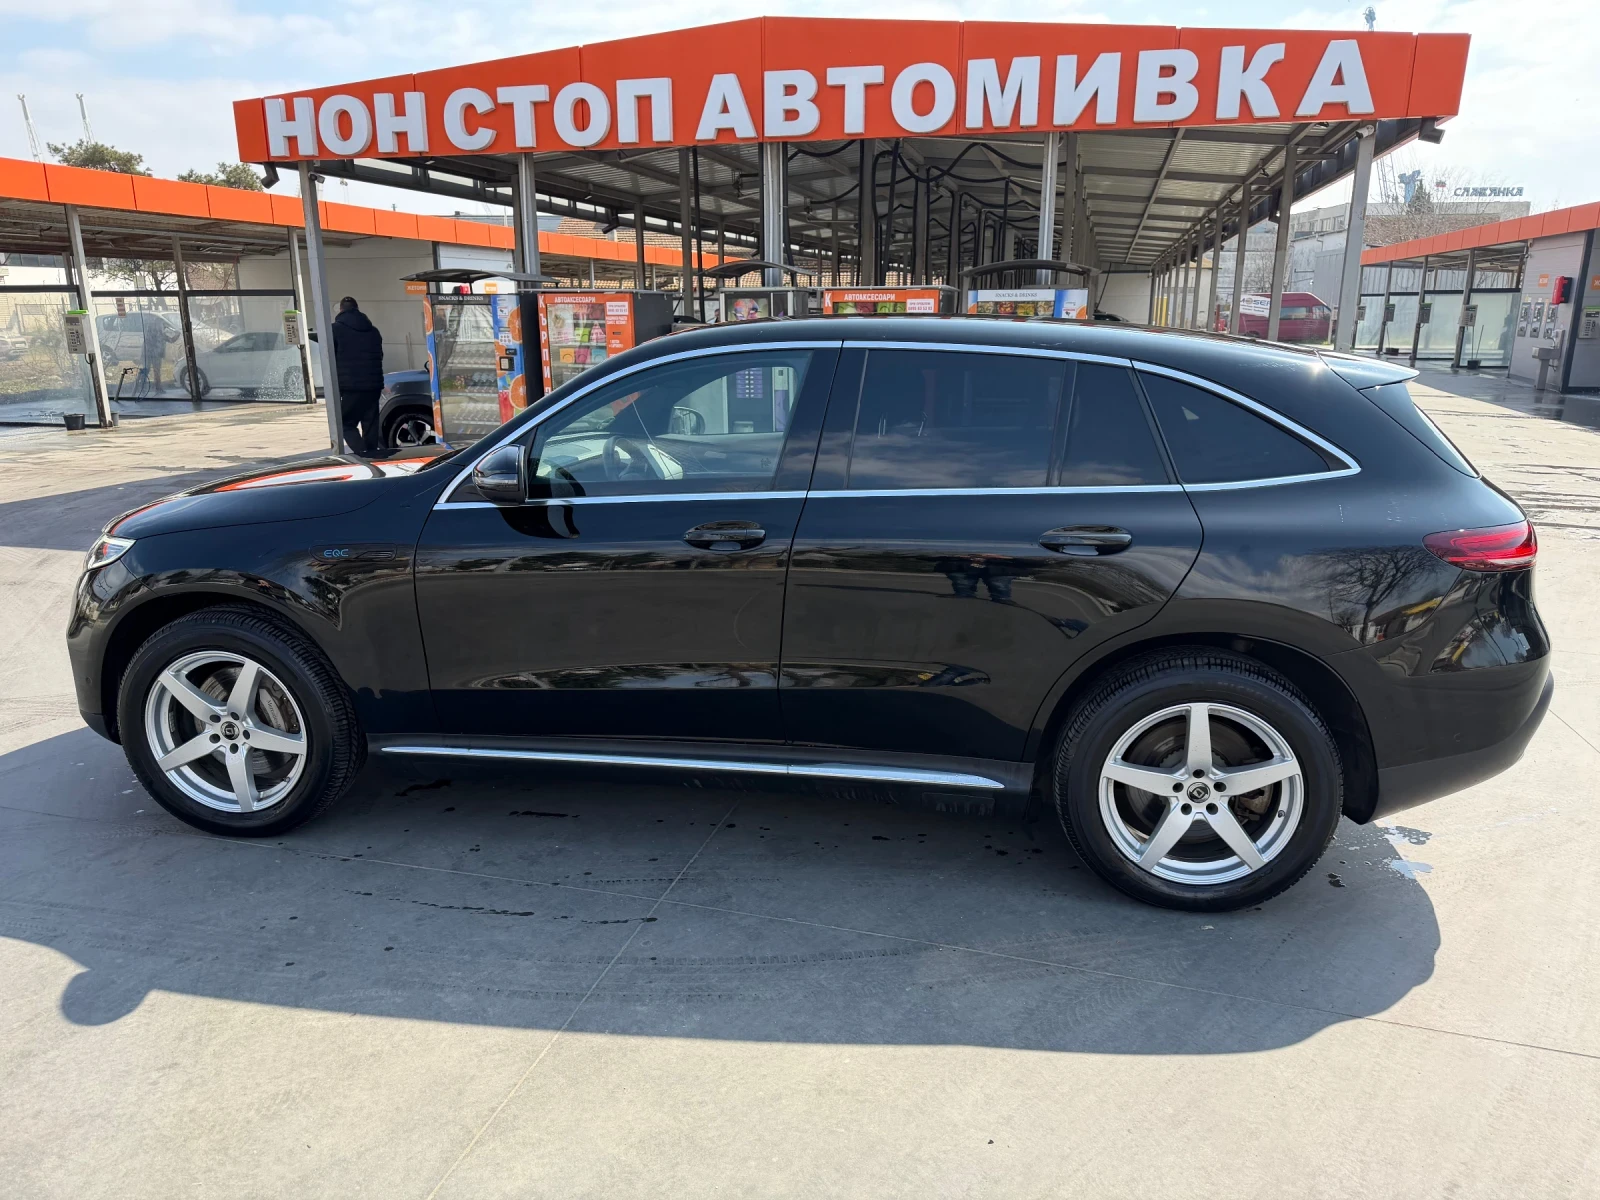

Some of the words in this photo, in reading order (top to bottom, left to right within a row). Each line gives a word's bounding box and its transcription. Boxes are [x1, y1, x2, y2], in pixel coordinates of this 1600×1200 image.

[264, 91, 429, 157] НОН
[443, 77, 674, 151] СТОП
[695, 38, 1376, 141] АВТОМИВКА
[844, 293, 896, 301] АВТОАКСЕСОАРИ
[323, 548, 349, 558] EQC
